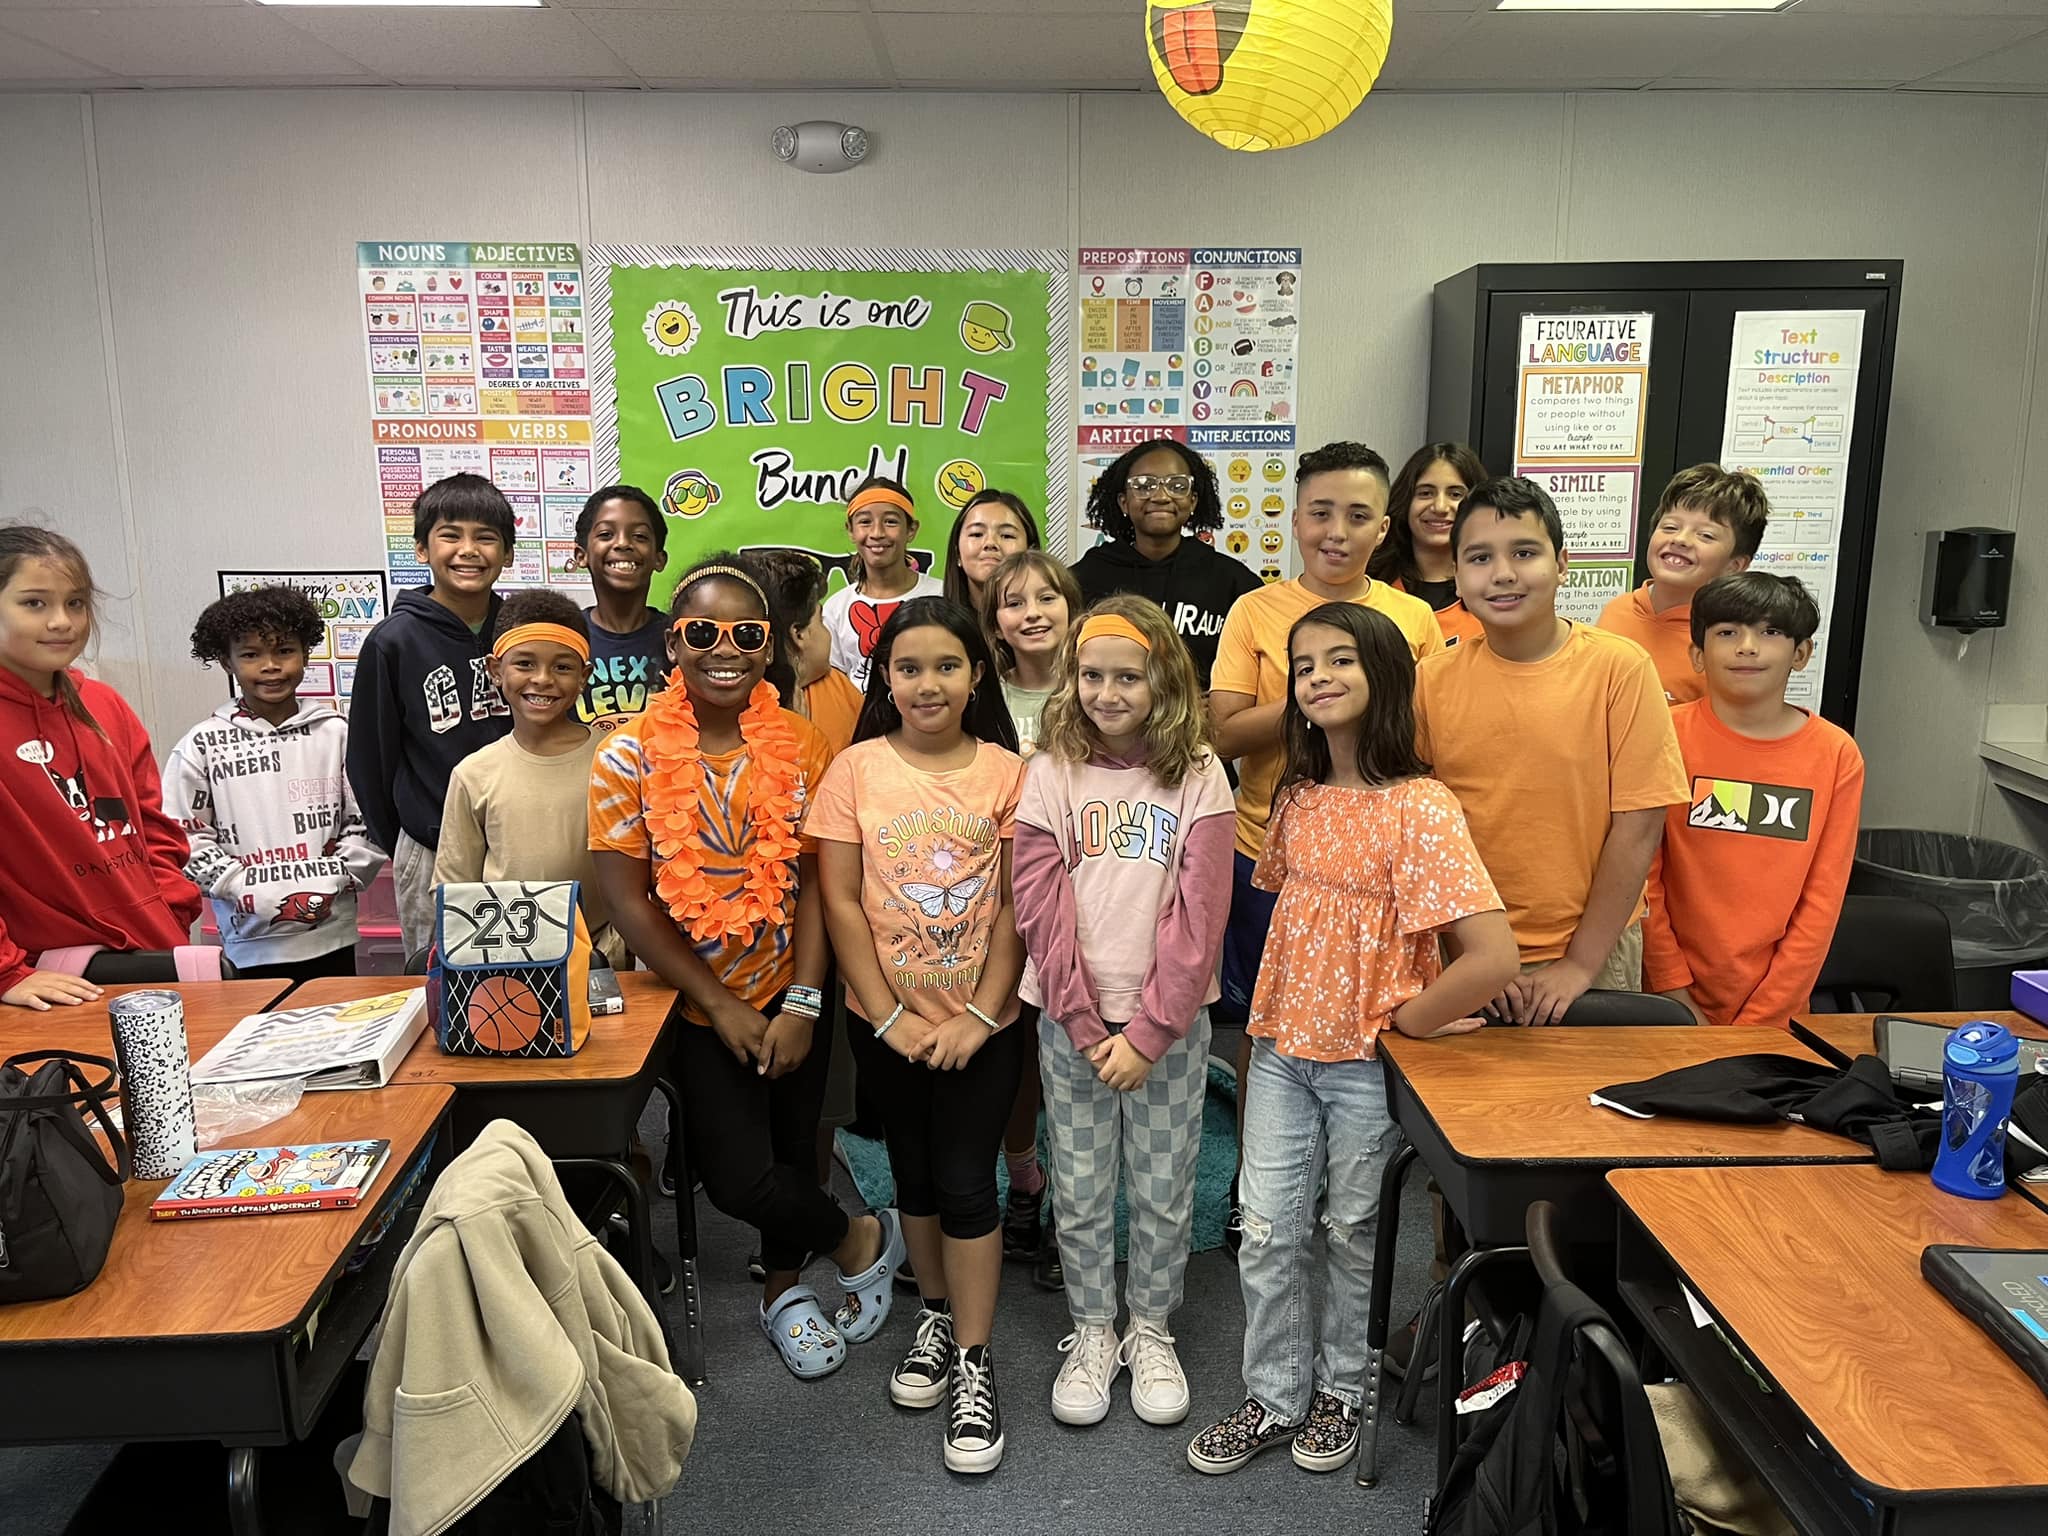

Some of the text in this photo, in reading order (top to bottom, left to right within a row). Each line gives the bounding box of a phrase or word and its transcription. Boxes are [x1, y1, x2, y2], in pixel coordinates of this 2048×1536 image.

[378, 245, 446, 261] NOUNS
[475, 246, 576, 262] ADJECTIVES
[1083, 252, 1185, 264] PREPOSITIONS
[1194, 250, 1297, 264] CONJUNCTIONS
[516, 281, 541, 295] 123
[720, 288, 930, 336] This is one
[1538, 320, 1637, 341] FIGURATIVE
[1781, 329, 1818, 344] Text
[1529, 342, 1642, 362] LANGUAGE
[1754, 350, 1840, 364] Structure
[1215, 364, 1226, 372] OR
[1542, 376, 1624, 394] METAPHOR
[1758, 372, 1830, 386] Description
[1215, 386, 1227, 394] YET
[656, 364, 1007, 440] BRIGHT
[1530, 398, 1580, 406] compares
[1605, 396, 1634, 406] things
[1214, 408, 1224, 416] SO
[1550, 410, 1586, 419] people
[1589, 410, 1625, 418] without
[378, 424, 477, 438] PRONOUNS
[508, 424, 568, 439] VERBS
[1544, 424, 1570, 432] using
[1573, 424, 1590, 432] like
[1605, 424, 1616, 432] as
[1090, 428, 1173, 443] ARTICLES
[1191, 430, 1290, 443] INTERJECTIONS
[1798, 466, 1832, 476] Order
[1550, 475, 1606, 492] SIMILE
[1600, 495, 1628, 504] things
[1582, 508, 1594, 517] by
[1596, 508, 1621, 517] using
[1754, 552, 1830, 562] ological Order
[1592, 590, 1618, 598] same
[321, 598, 377, 618] DAY
[1566, 603, 1598, 611] sounds
[588, 656, 649, 685] NEX
[422, 657, 511, 735] GA
[575, 684, 647, 723] LEV
[472, 898, 540, 949] 23
[895, 970, 918, 988] on
[922, 970, 953, 990] my
